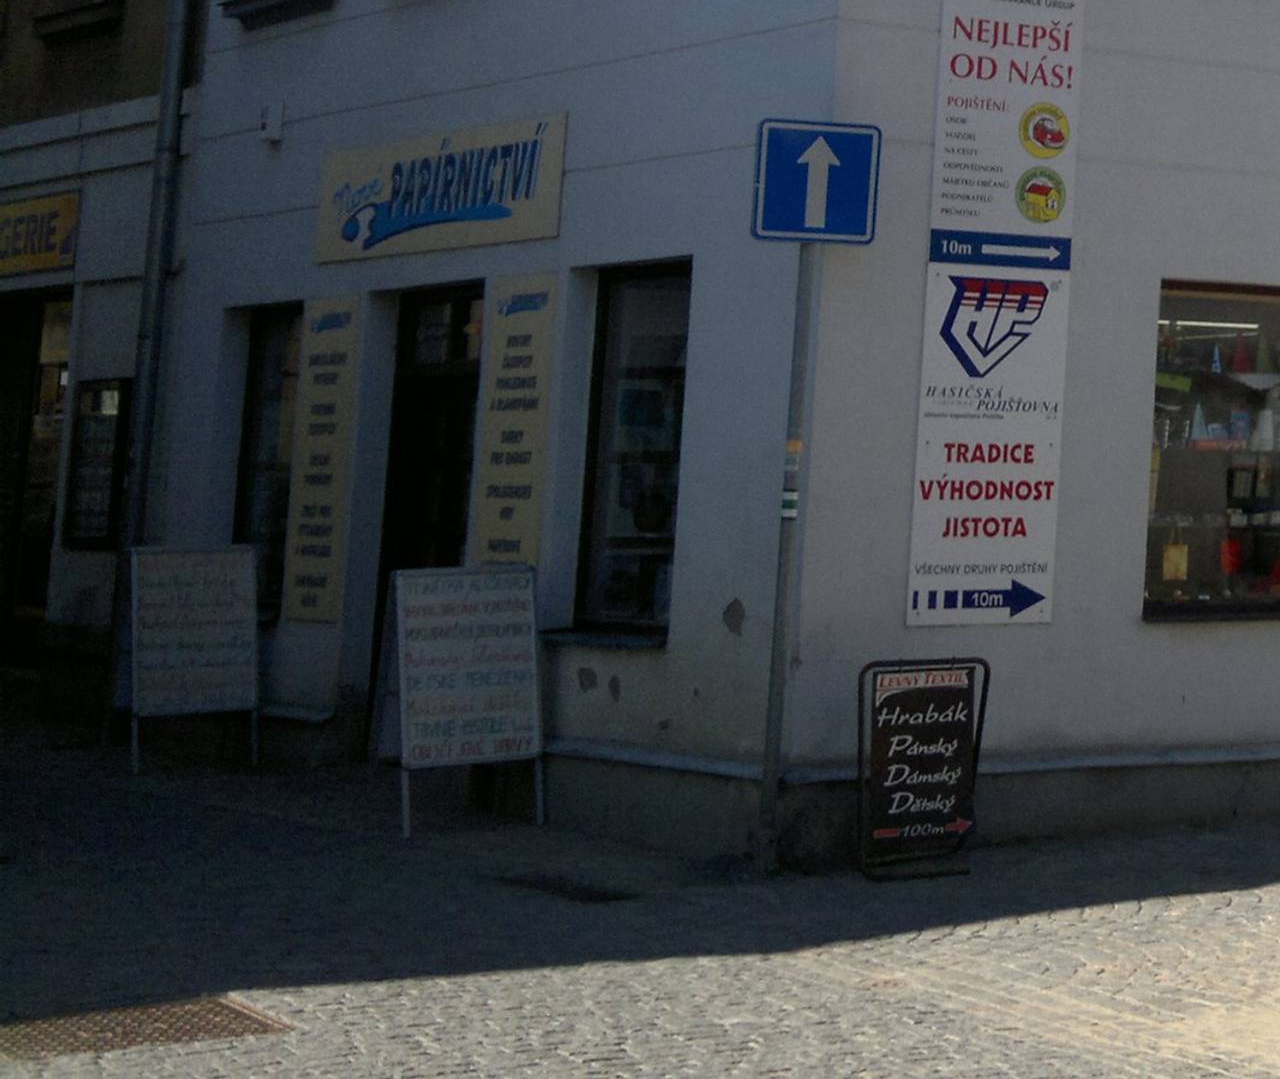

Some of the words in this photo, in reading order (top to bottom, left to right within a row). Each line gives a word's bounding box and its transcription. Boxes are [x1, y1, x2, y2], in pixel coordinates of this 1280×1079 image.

[953, 16, 1072, 52] NEJLEPŠÍ
[950, 53, 997, 81] OD
[1009, 55, 1073, 90] NÁS!
[390, 122, 548, 219] PAPÍRNICTVÍ
[941, 239, 972, 255] 10m
[925, 384, 1004, 399] HASIČSKÁ
[976, 397, 1059, 413] POJIŠŤOVNA
[944, 442, 1035, 464] TRADICE
[920, 474, 1055, 501] VÝHODNOST
[942, 517, 1027, 538] JISTOTA
[915, 563, 960, 575] VŠECHNY
[964, 564, 998, 575] DRUHY
[971, 592, 1003, 606] 10m
[877, 701, 968, 728] Hrabák
[888, 734, 958, 758] Pánský
[883, 764, 962, 787] Dámský
[888, 791, 956, 814] Dětský
[903, 823, 945, 837] 100m
